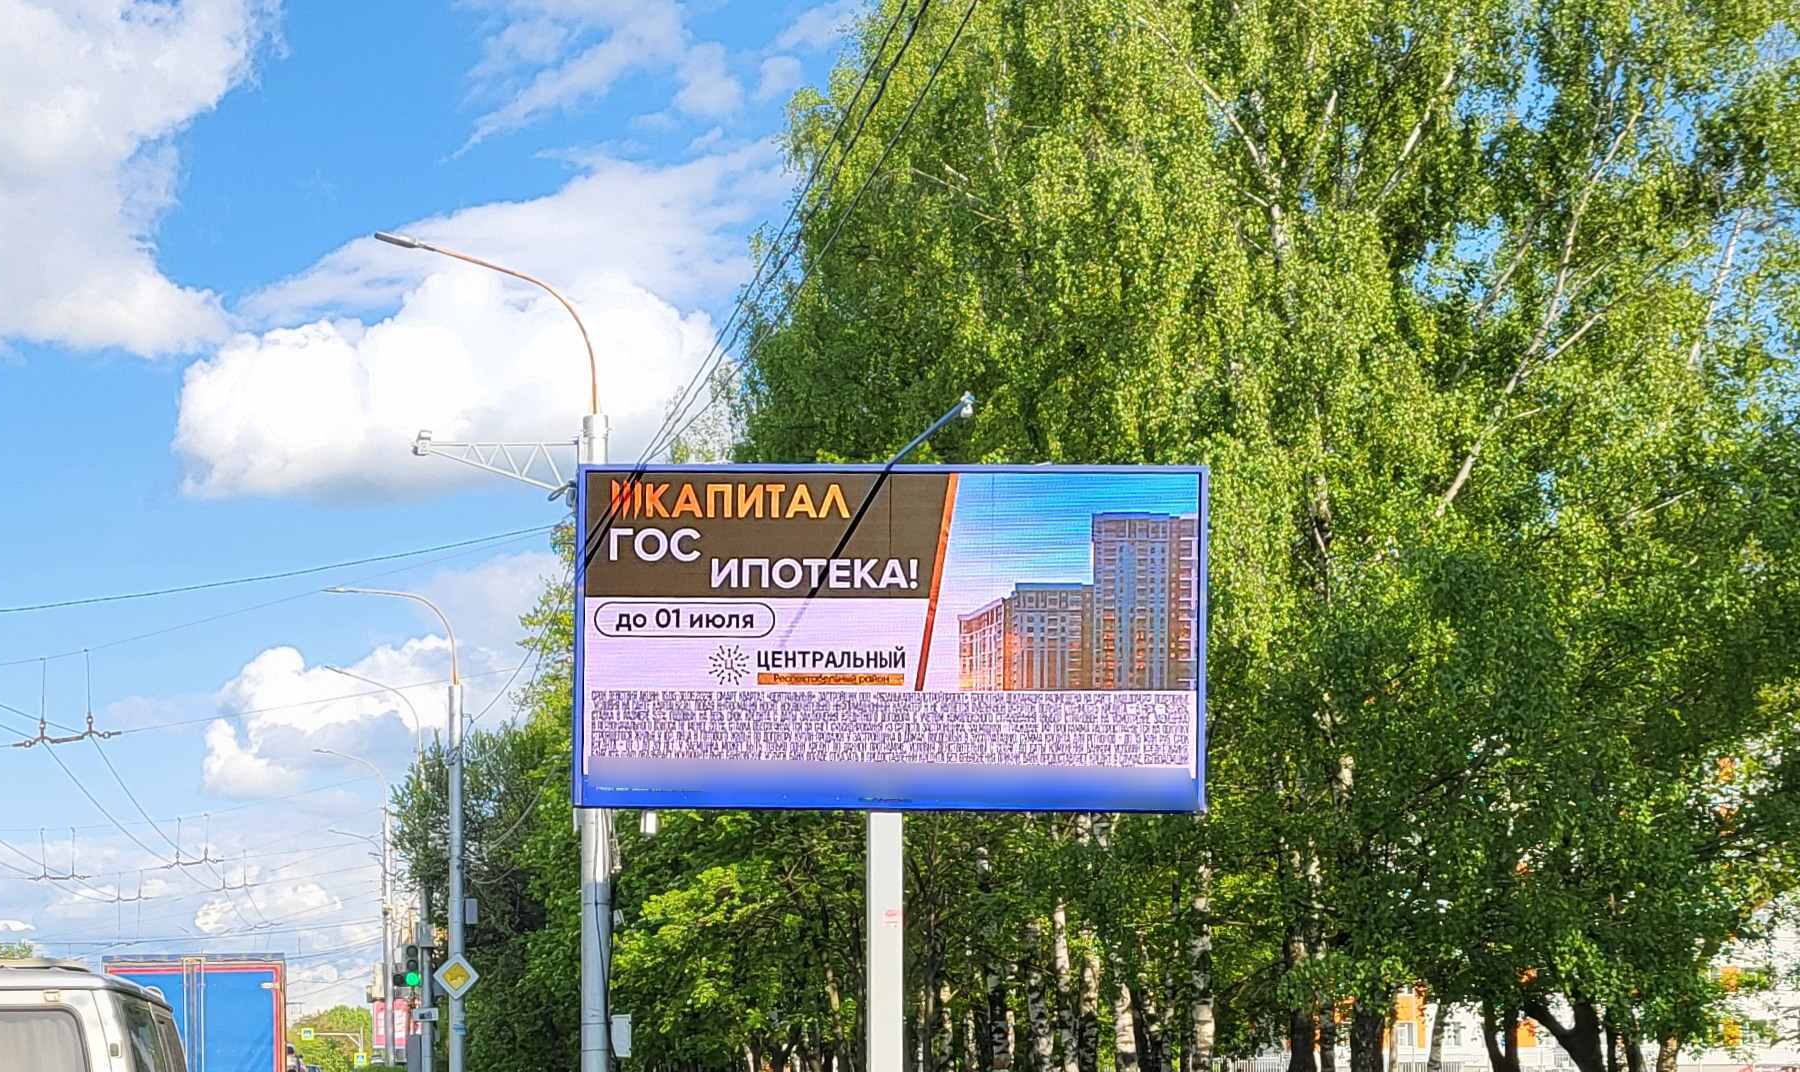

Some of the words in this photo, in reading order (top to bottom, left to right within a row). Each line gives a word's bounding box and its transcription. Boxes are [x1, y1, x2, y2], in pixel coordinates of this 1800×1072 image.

[608, 527, 702, 562] ГОС
[711, 558, 919, 589] ИПОТЕКА!
[616, 612, 647, 631] до
[655, 608, 680, 629] 01
[689, 611, 755, 629] июля
[757, 646, 906, 671] ЦЕНТРАЛЬНЫЙ
